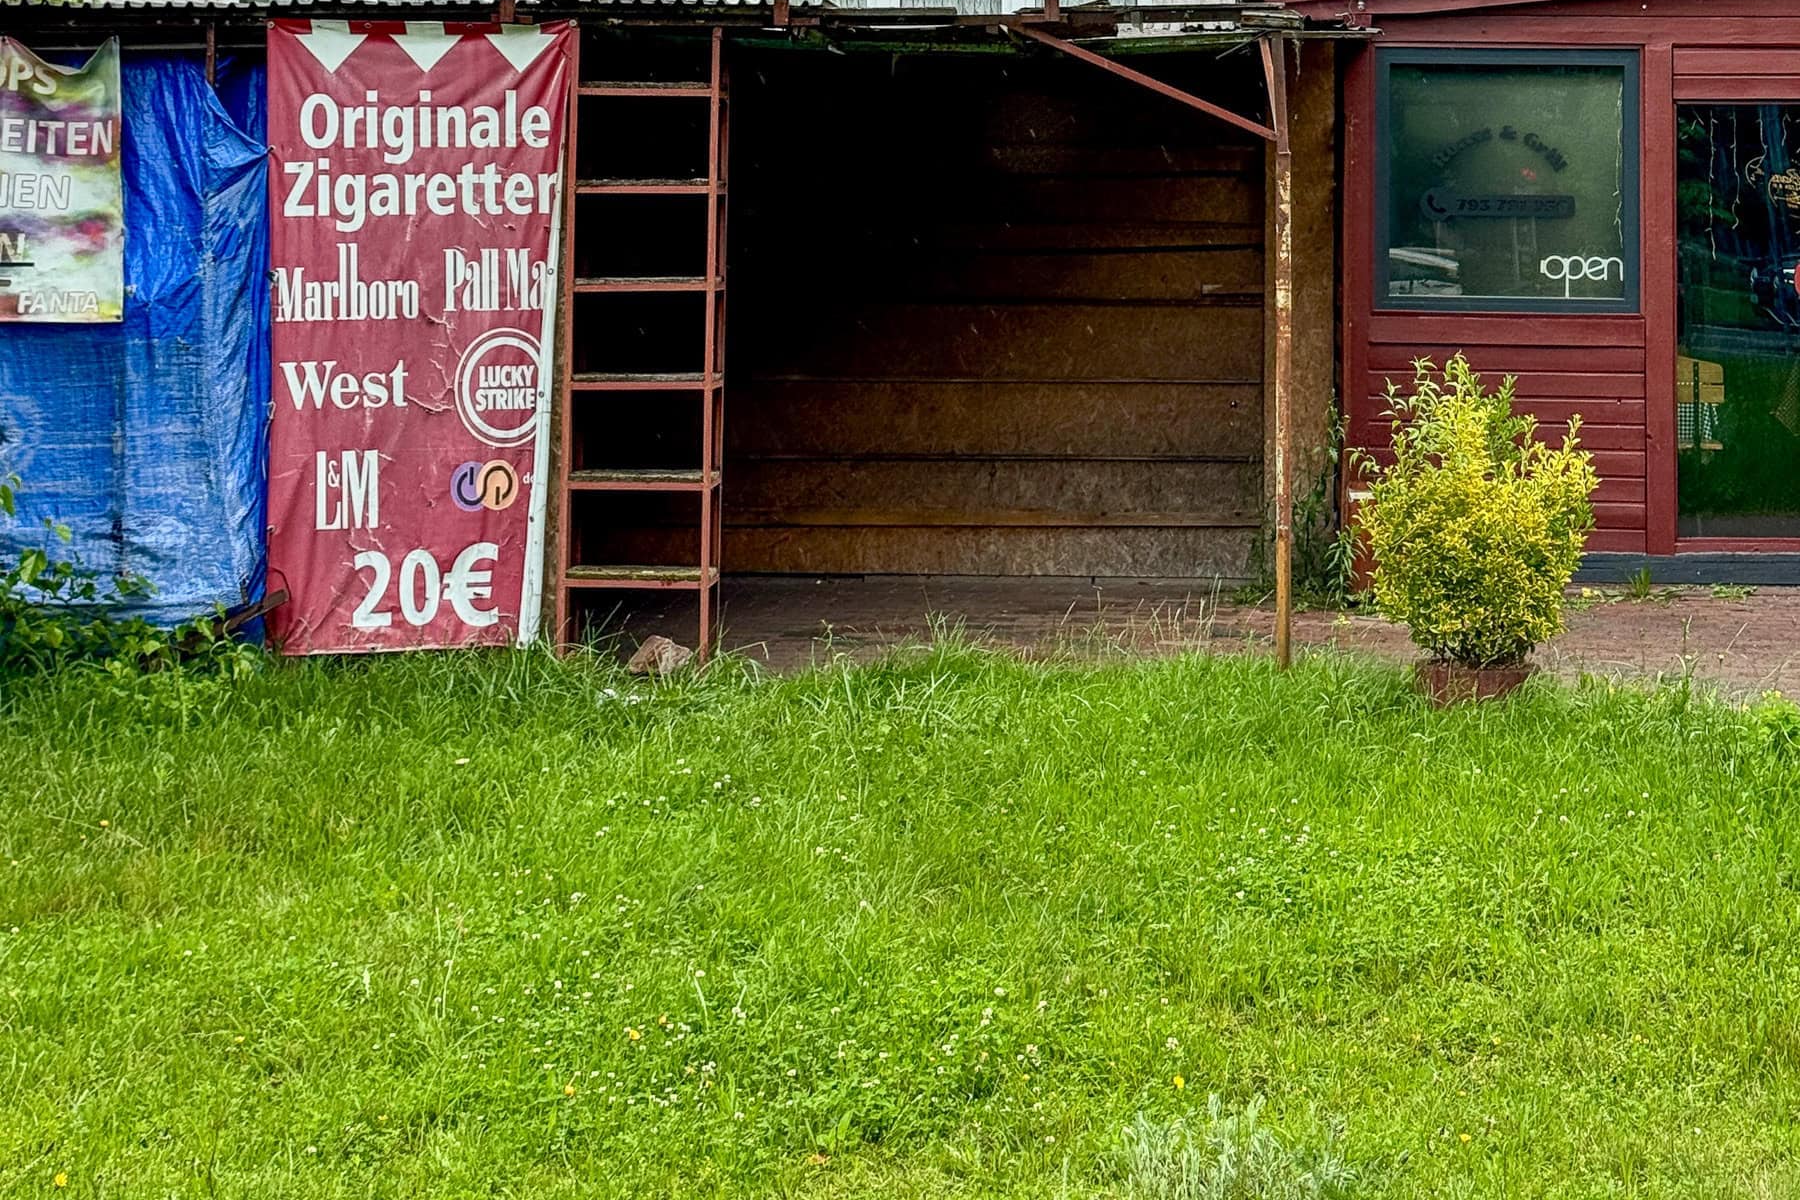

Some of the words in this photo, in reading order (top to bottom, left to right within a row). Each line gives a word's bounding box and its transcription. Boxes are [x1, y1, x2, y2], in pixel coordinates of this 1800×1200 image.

[300, 90, 551, 165] Originale
[17, 291, 98, 314] FANTA
[275, 243, 420, 322] Marlboro
[443, 247, 500, 312] Pall
[1542, 255, 1623, 298] open
[280, 359, 408, 410] West
[475, 388, 536, 412] STRIKE
[478, 364, 535, 388] LUCKY
[315, 449, 379, 530] L&M
[352, 542, 499, 627] 20€
